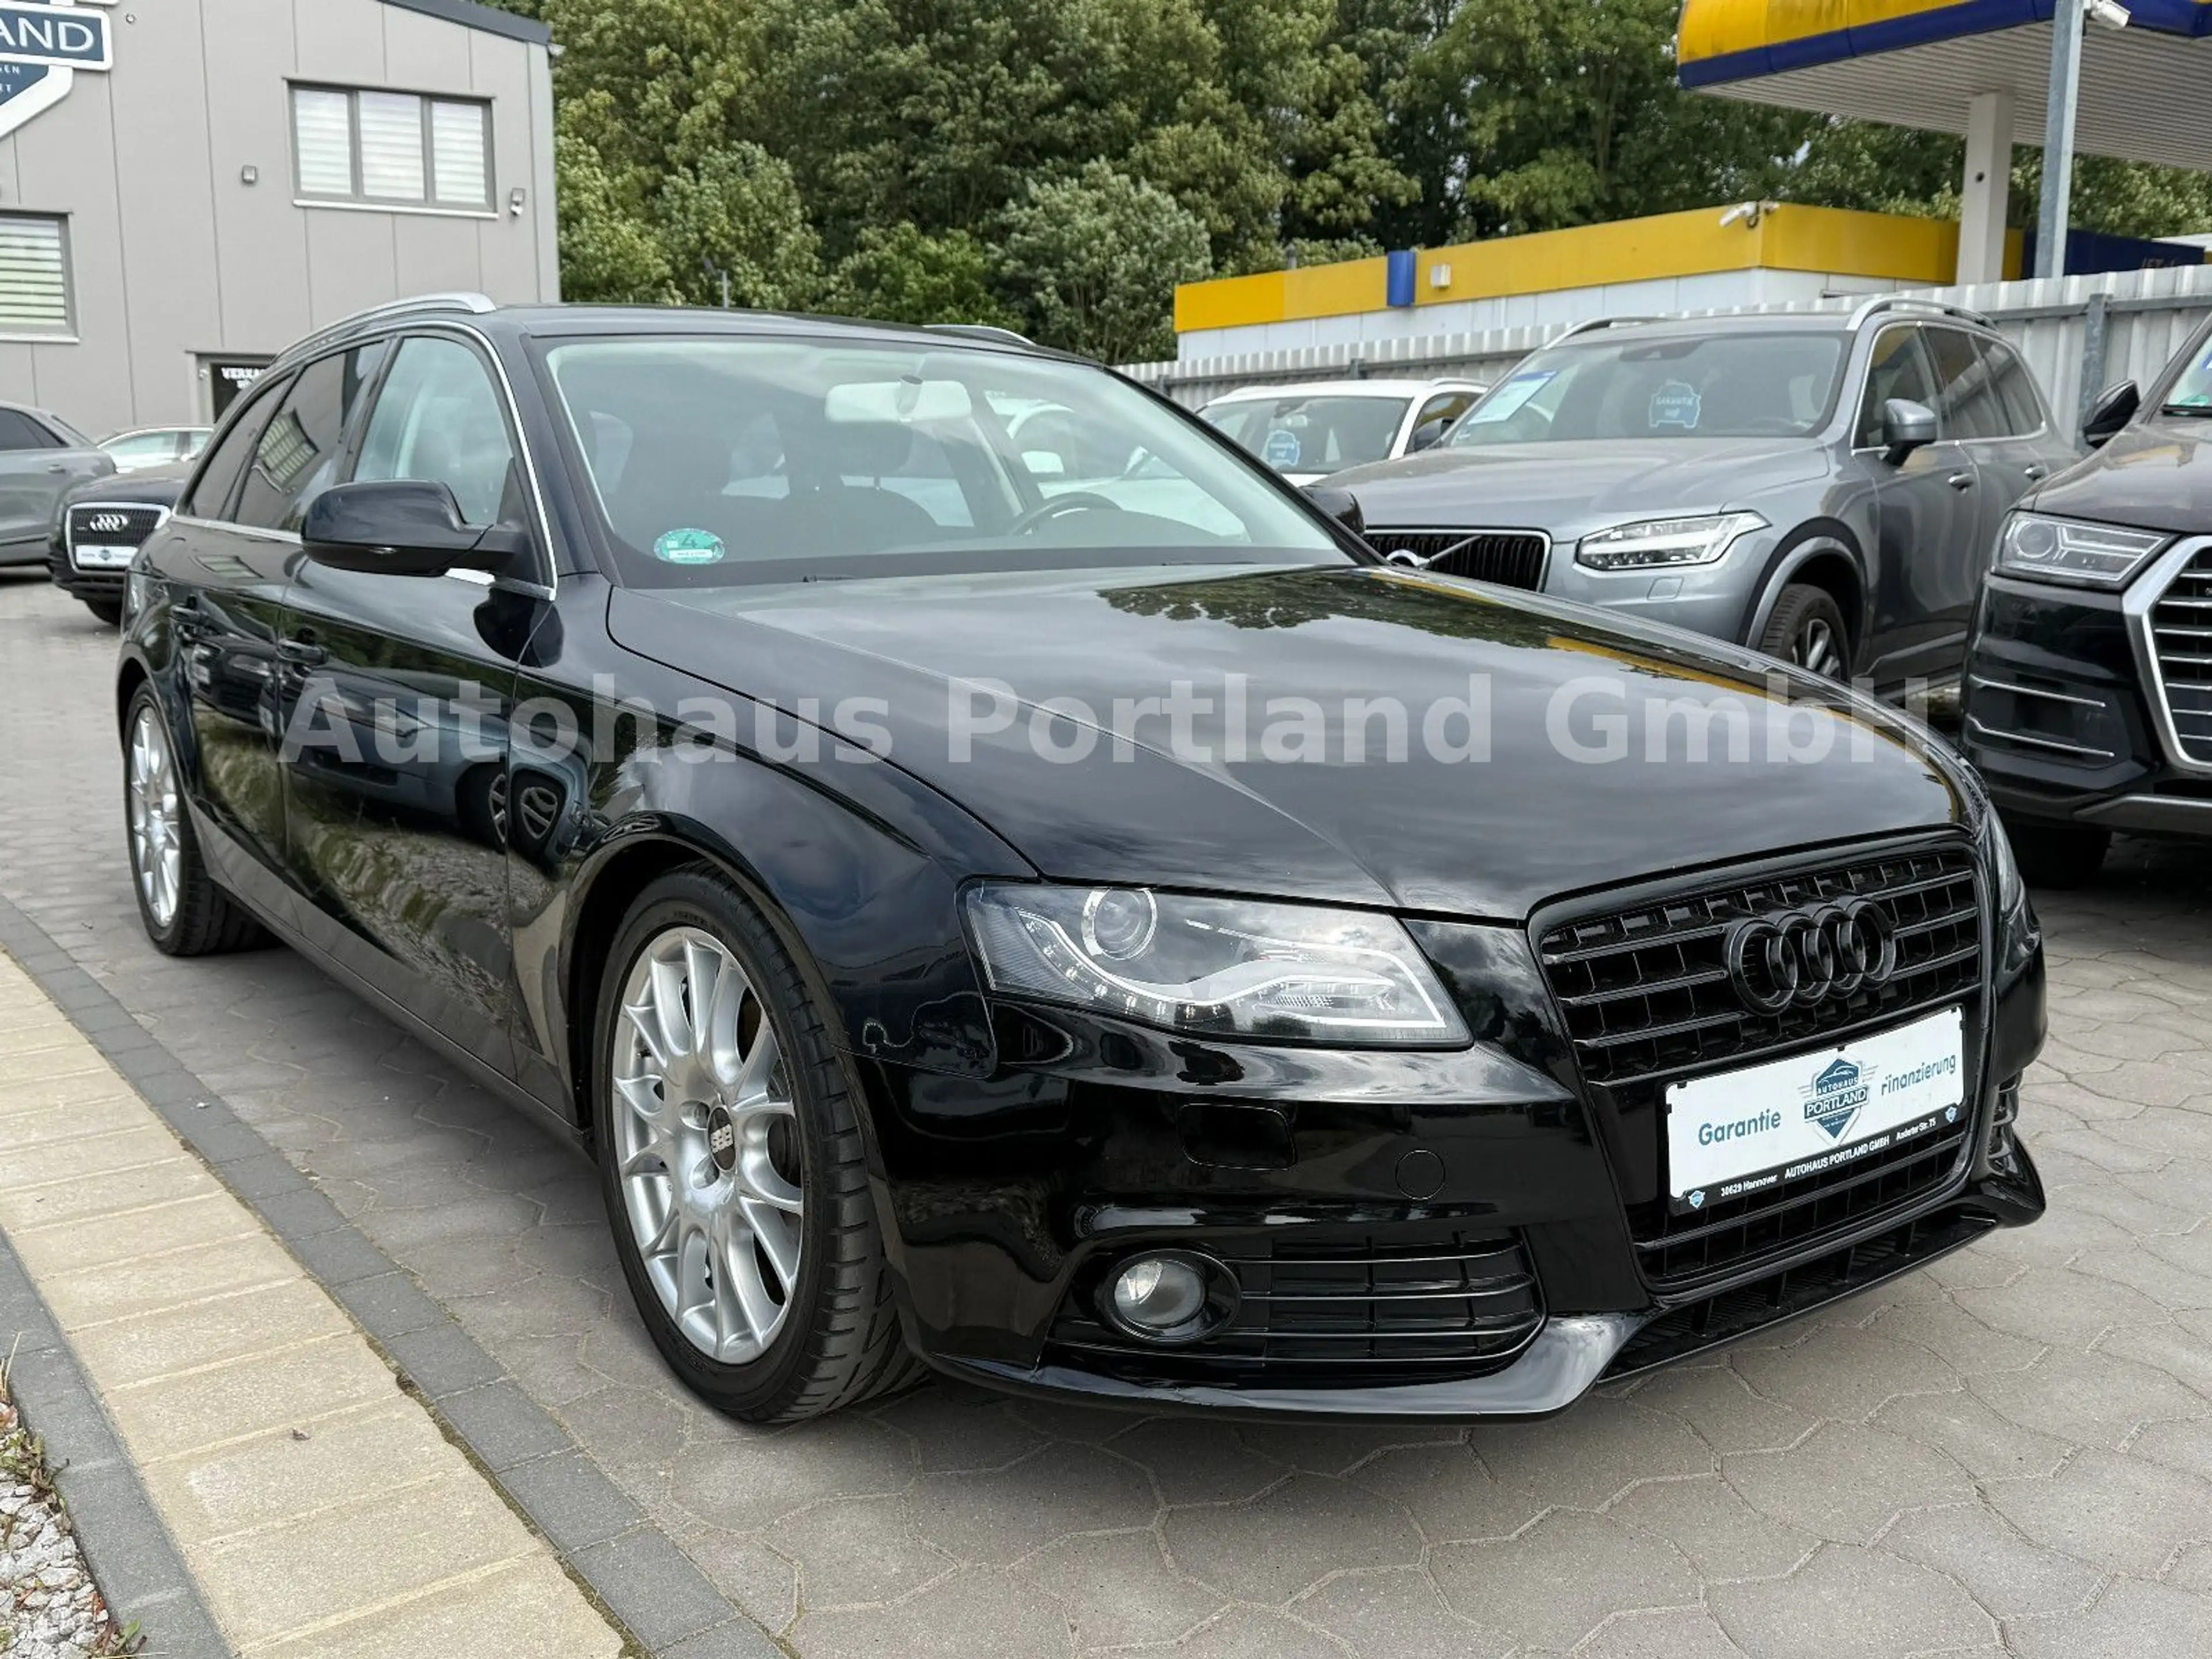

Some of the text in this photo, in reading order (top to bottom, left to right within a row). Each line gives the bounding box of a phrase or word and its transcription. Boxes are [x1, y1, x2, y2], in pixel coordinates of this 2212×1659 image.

[681, 533, 698, 548] 4
[1818, 1077, 1858, 1094] AUTOHAUS
[1881, 1054, 1956, 1096] Finanzierung
[1806, 1088, 1866, 1117] PORTLAND
[1698, 1108, 1782, 1146] Garantie
[1785, 1135, 1889, 1179] AUTOHAUS PORTLAND GMBH
